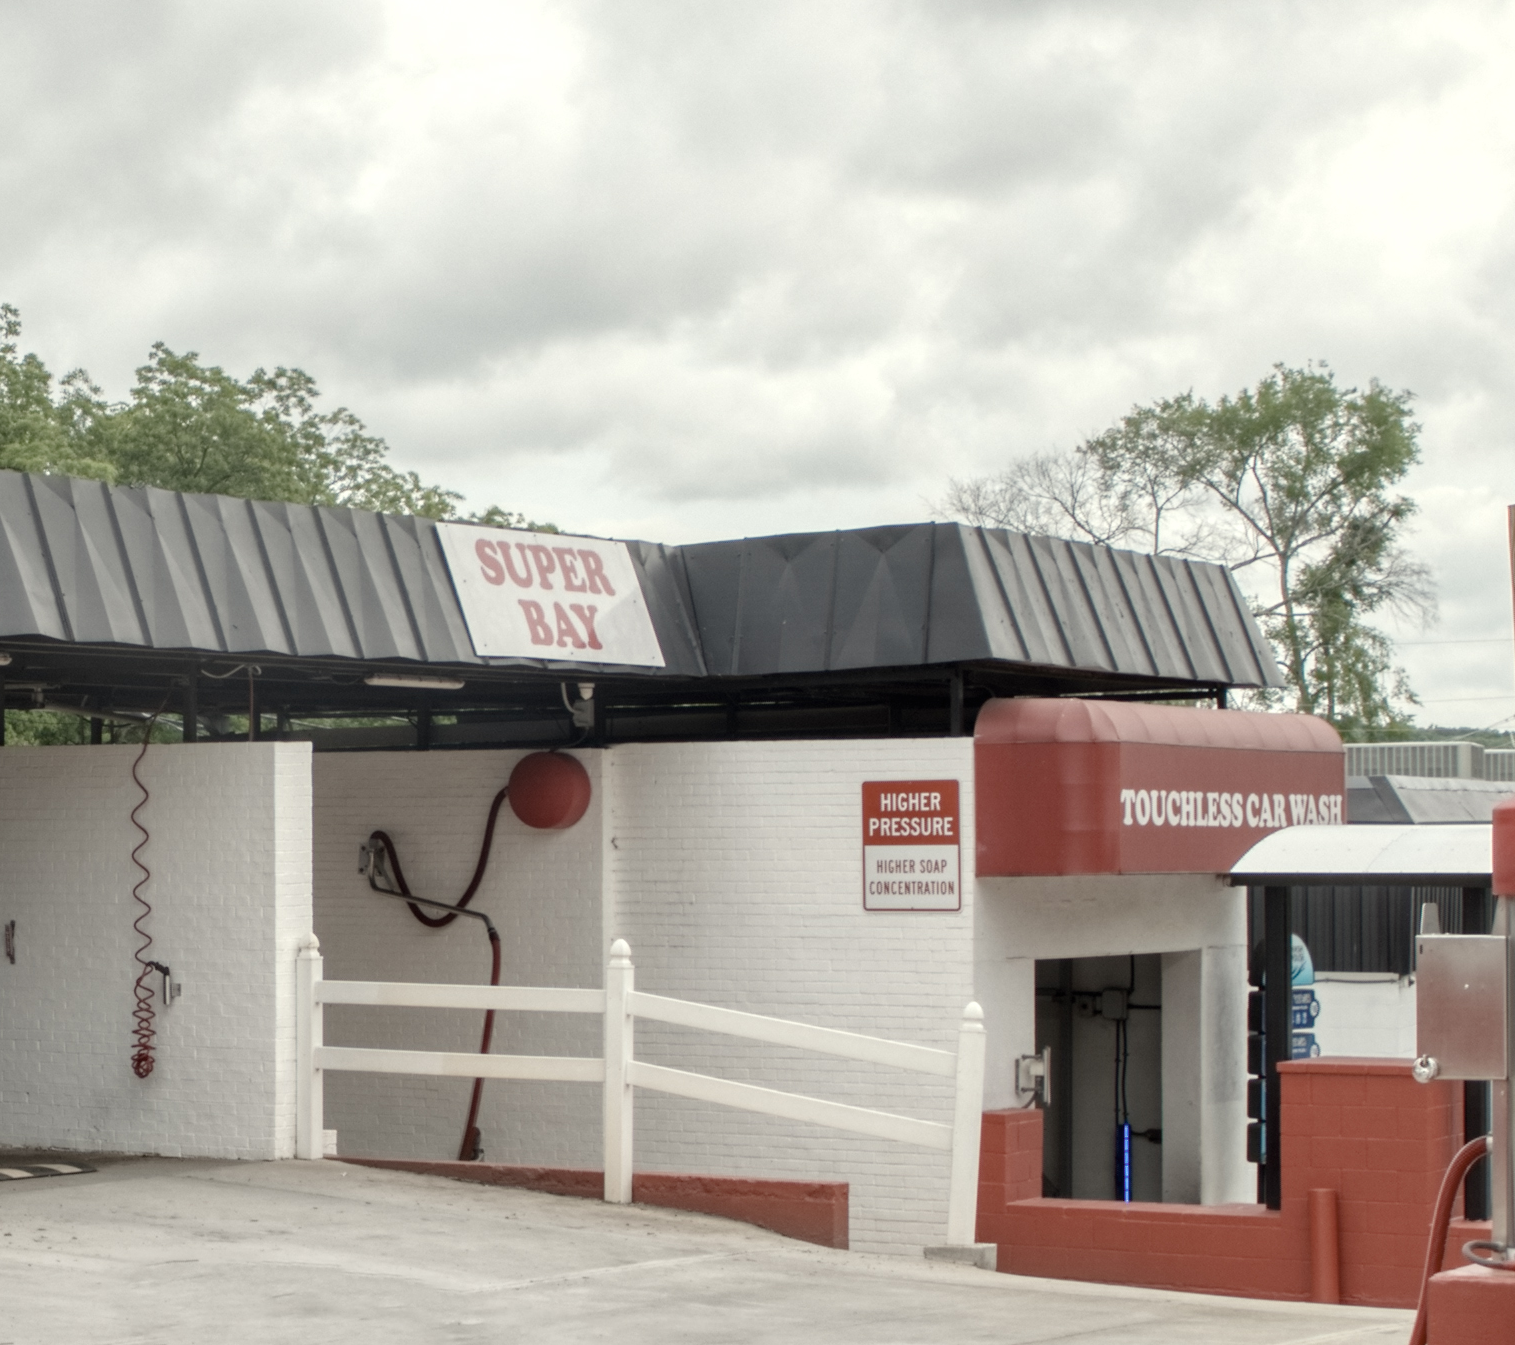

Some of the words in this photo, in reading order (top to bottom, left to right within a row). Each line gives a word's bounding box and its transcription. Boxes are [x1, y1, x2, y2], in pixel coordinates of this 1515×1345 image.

[474, 538, 616, 596] SUPER
[517, 599, 603, 650] BAY
[880, 792, 941, 812] HIGHER
[1120, 788, 1243, 827] TOUCHLESS
[1246, 793, 1288, 828] CAR
[1289, 793, 1343, 825] WASH
[869, 817, 954, 837] PRESSURE
[876, 859, 916, 874] HIGHER
[919, 859, 948, 874] SOAP
[869, 881, 955, 896] CONCENTRATION
